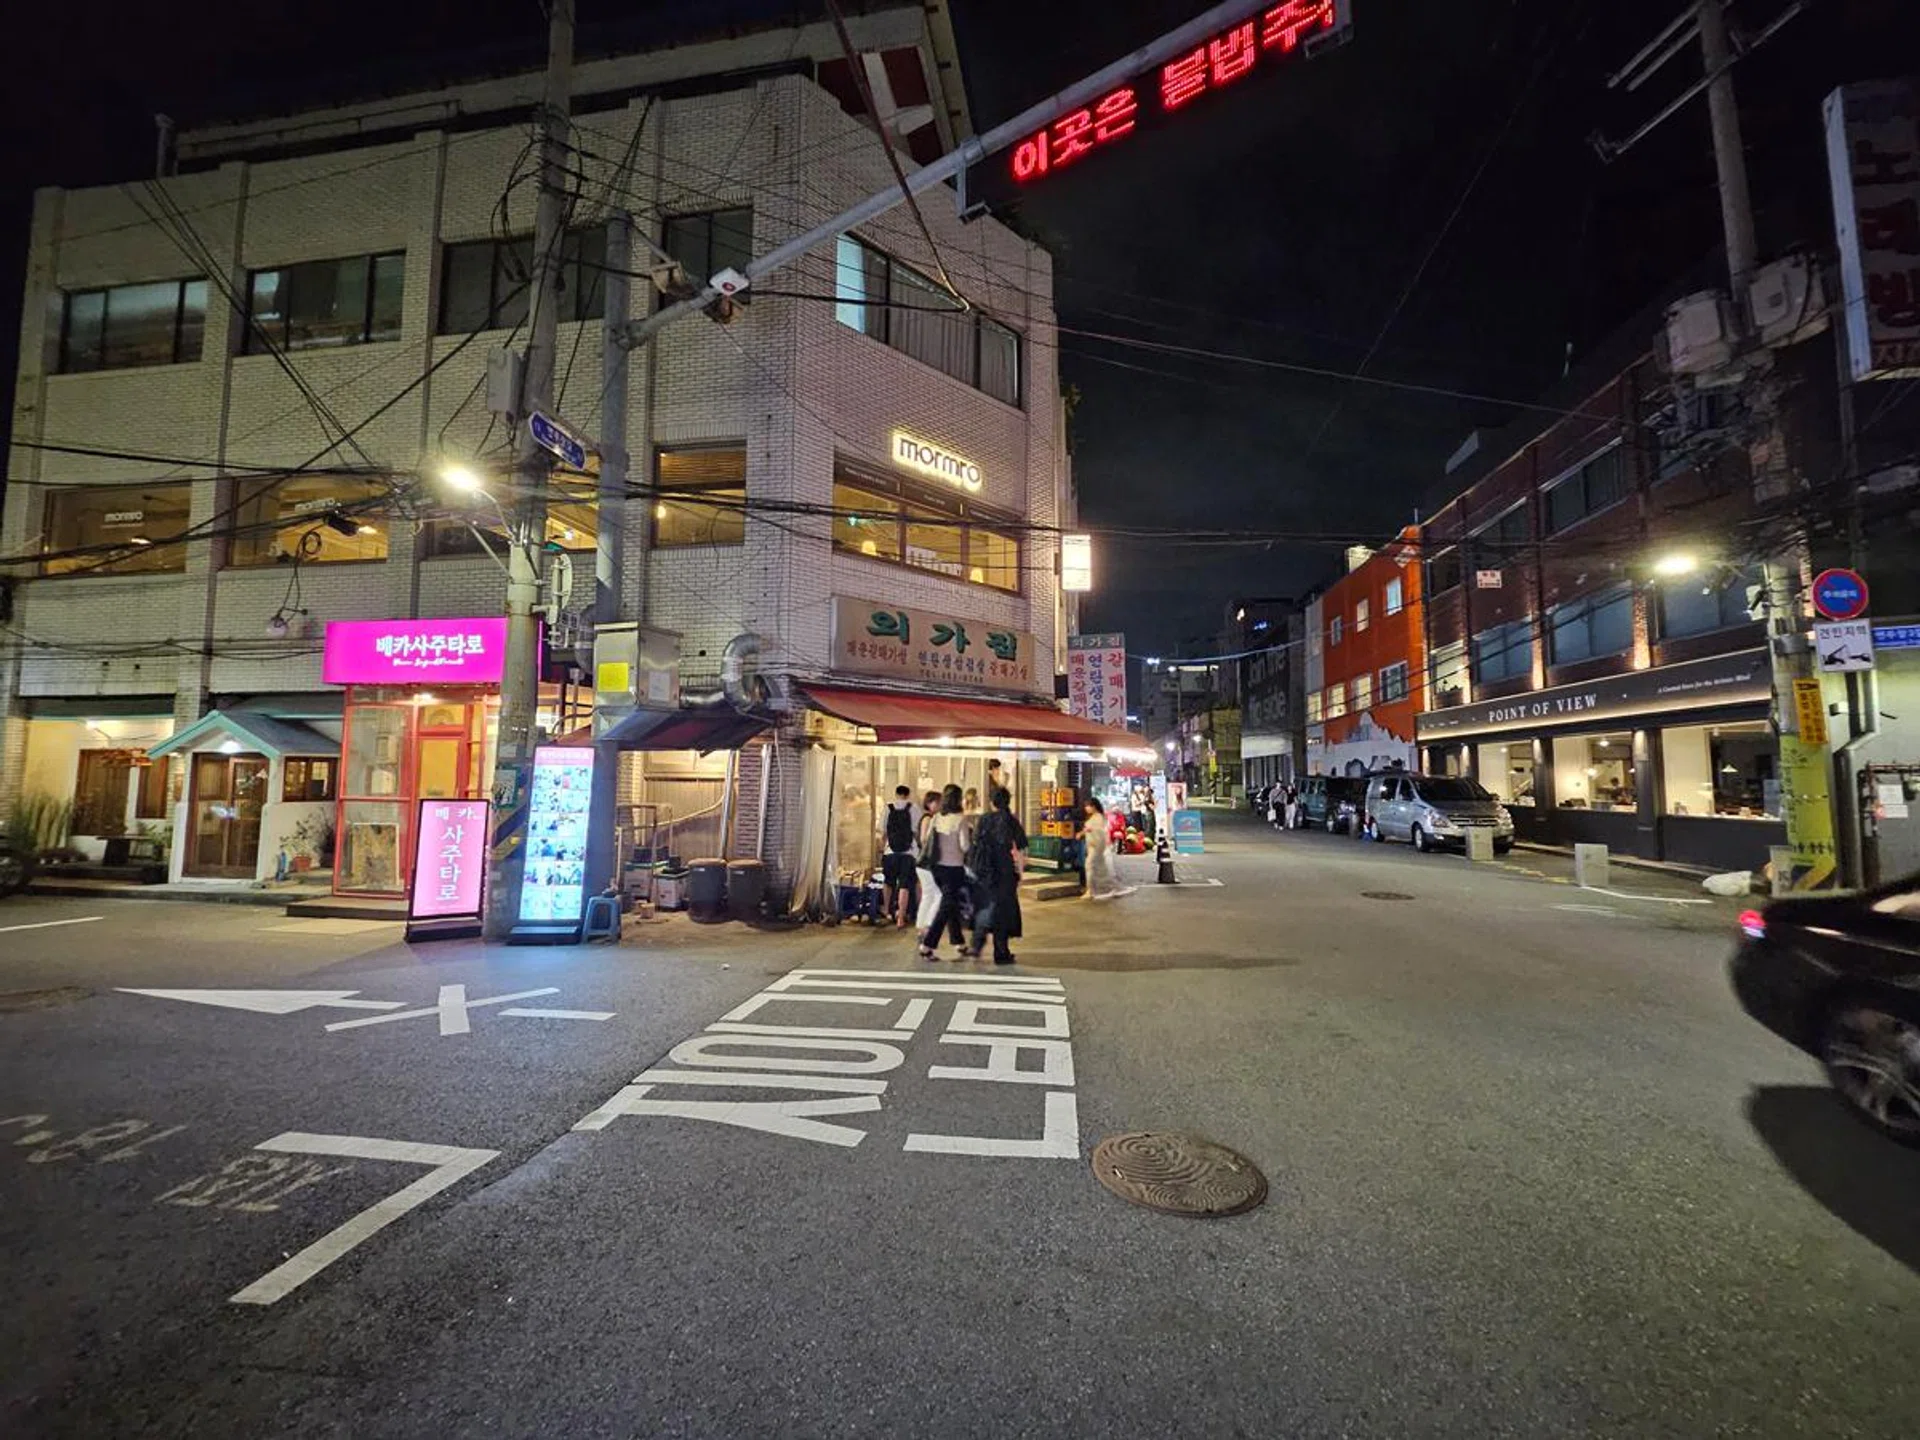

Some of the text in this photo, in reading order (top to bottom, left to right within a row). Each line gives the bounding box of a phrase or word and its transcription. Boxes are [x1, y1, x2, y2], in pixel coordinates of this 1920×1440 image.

[1013, 88, 1137, 180] 이곳은
[899, 437, 981, 484] mormro
[1819, 625, 1868, 640] 견인지역
[1488, 693, 1598, 723] POINT OF VIEW
[435, 824, 464, 901] 사주타로
